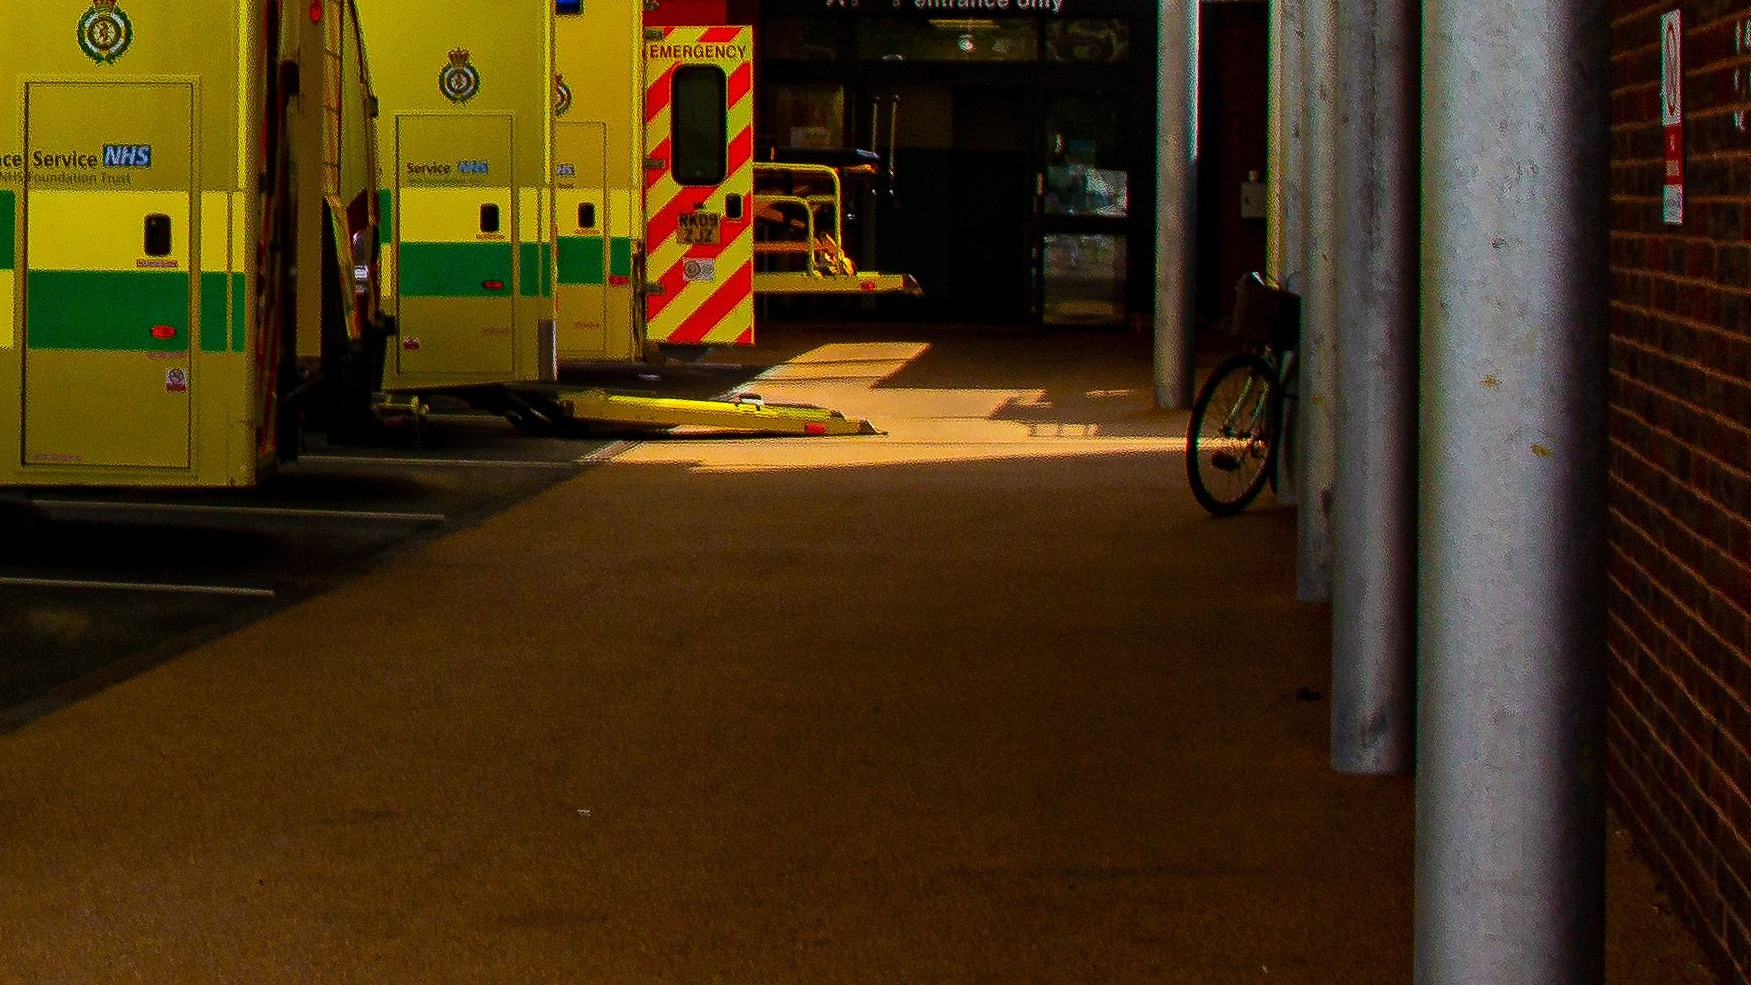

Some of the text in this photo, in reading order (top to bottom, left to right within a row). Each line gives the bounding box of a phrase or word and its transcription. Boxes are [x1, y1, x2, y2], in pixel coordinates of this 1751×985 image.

[650, 44, 746, 58] EMERGENCY
[33, 151, 98, 169] Service
[103, 146, 150, 166] NHS
[406, 161, 451, 176] Service
